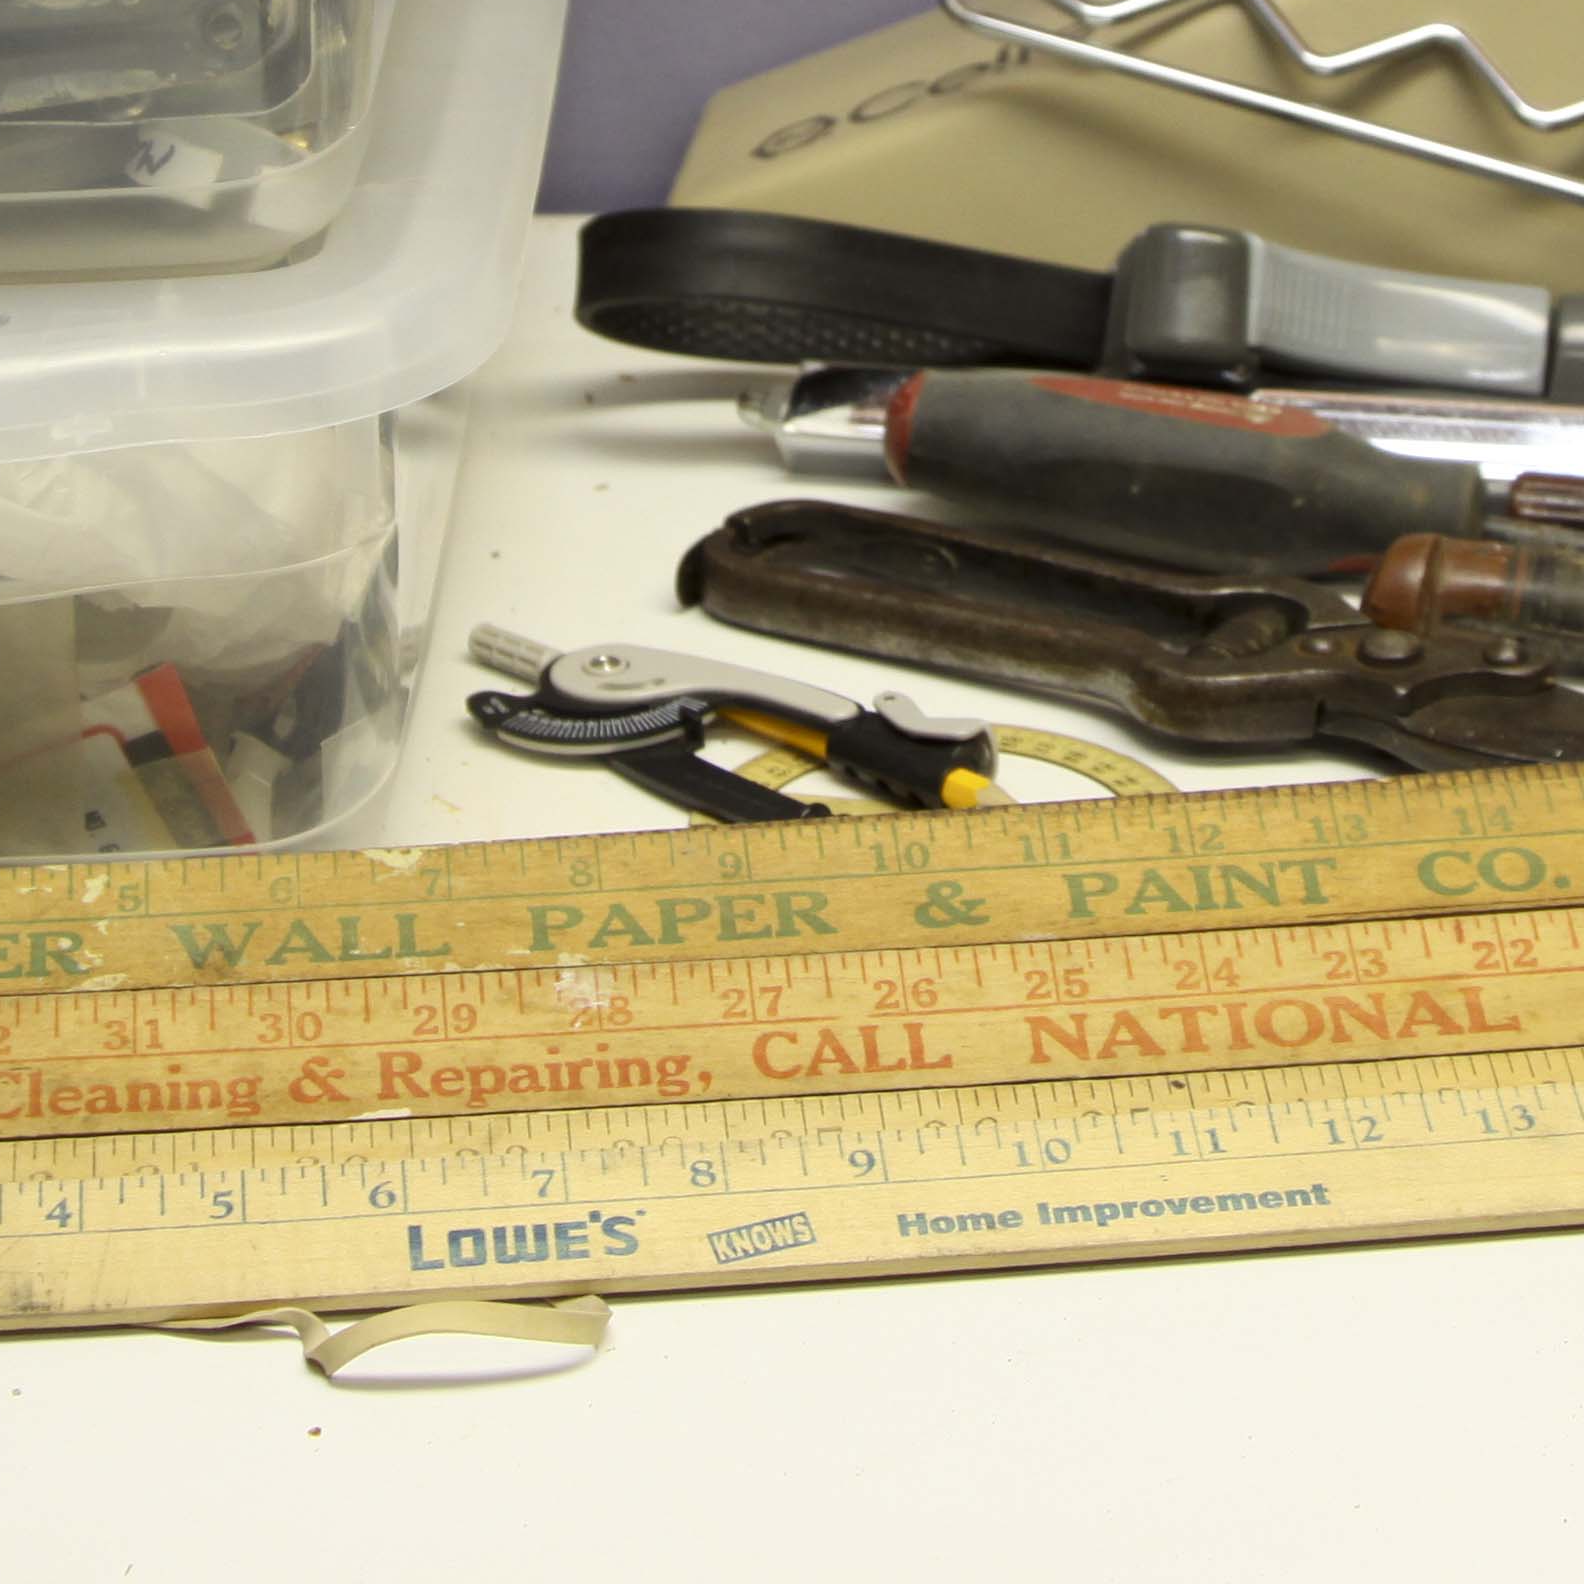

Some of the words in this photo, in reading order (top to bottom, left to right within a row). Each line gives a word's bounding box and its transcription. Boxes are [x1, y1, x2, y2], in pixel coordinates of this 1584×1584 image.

[119, 884, 143, 913] 5
[269, 877, 294, 905] 6
[417, 869, 441, 897] 7
[569, 859, 594, 887] 8
[718, 853, 743, 880] 9
[870, 841, 930, 872] 10
[1017, 833, 1076, 862] 11
[1164, 824, 1225, 854] 12
[1312, 816, 1369, 844] 13
[1454, 804, 1516, 835] 14
[169, 914, 451, 970] WALL
[528, 890, 838, 952] PAPER
[915, 881, 990, 929] &
[1064, 857, 1338, 917] PAINT
[1417, 847, 1572, 896] CO.
[102, 1019, 164, 1050] 31
[256, 1011, 323, 1042] 30
[413, 1004, 478, 1035] 29
[722, 987, 785, 1019] 27
[873, 978, 938, 1009] 26
[1024, 968, 1090, 1000] 25
[1174, 958, 1240, 989] 24
[1324, 949, 1389, 979] 23
[1473, 939, 1538, 969] 22
[288, 1056, 351, 1104] &
[376, 1042, 714, 1108] Repairing,
[752, 1022, 953, 1080] CALL
[1030, 986, 1521, 1064] NATIONAL
[46, 1199, 72, 1227] 4
[210, 1190, 235, 1218] 5
[370, 1182, 397, 1209] 6
[531, 1169, 556, 1197] 7
[690, 1160, 716, 1187] 8
[849, 1150, 876, 1177] 9
[1014, 1137, 1071, 1167] 10
[1170, 1129, 1226, 1156] 11
[1323, 1115, 1384, 1146] 12
[1475, 1105, 1537, 1134] 13
[407, 1211, 640, 1272] LOWE'S
[711, 1213, 814, 1262] KNOWS
[896, 1210, 1024, 1239] Home
[1036, 1183, 1330, 1227] Improvement
